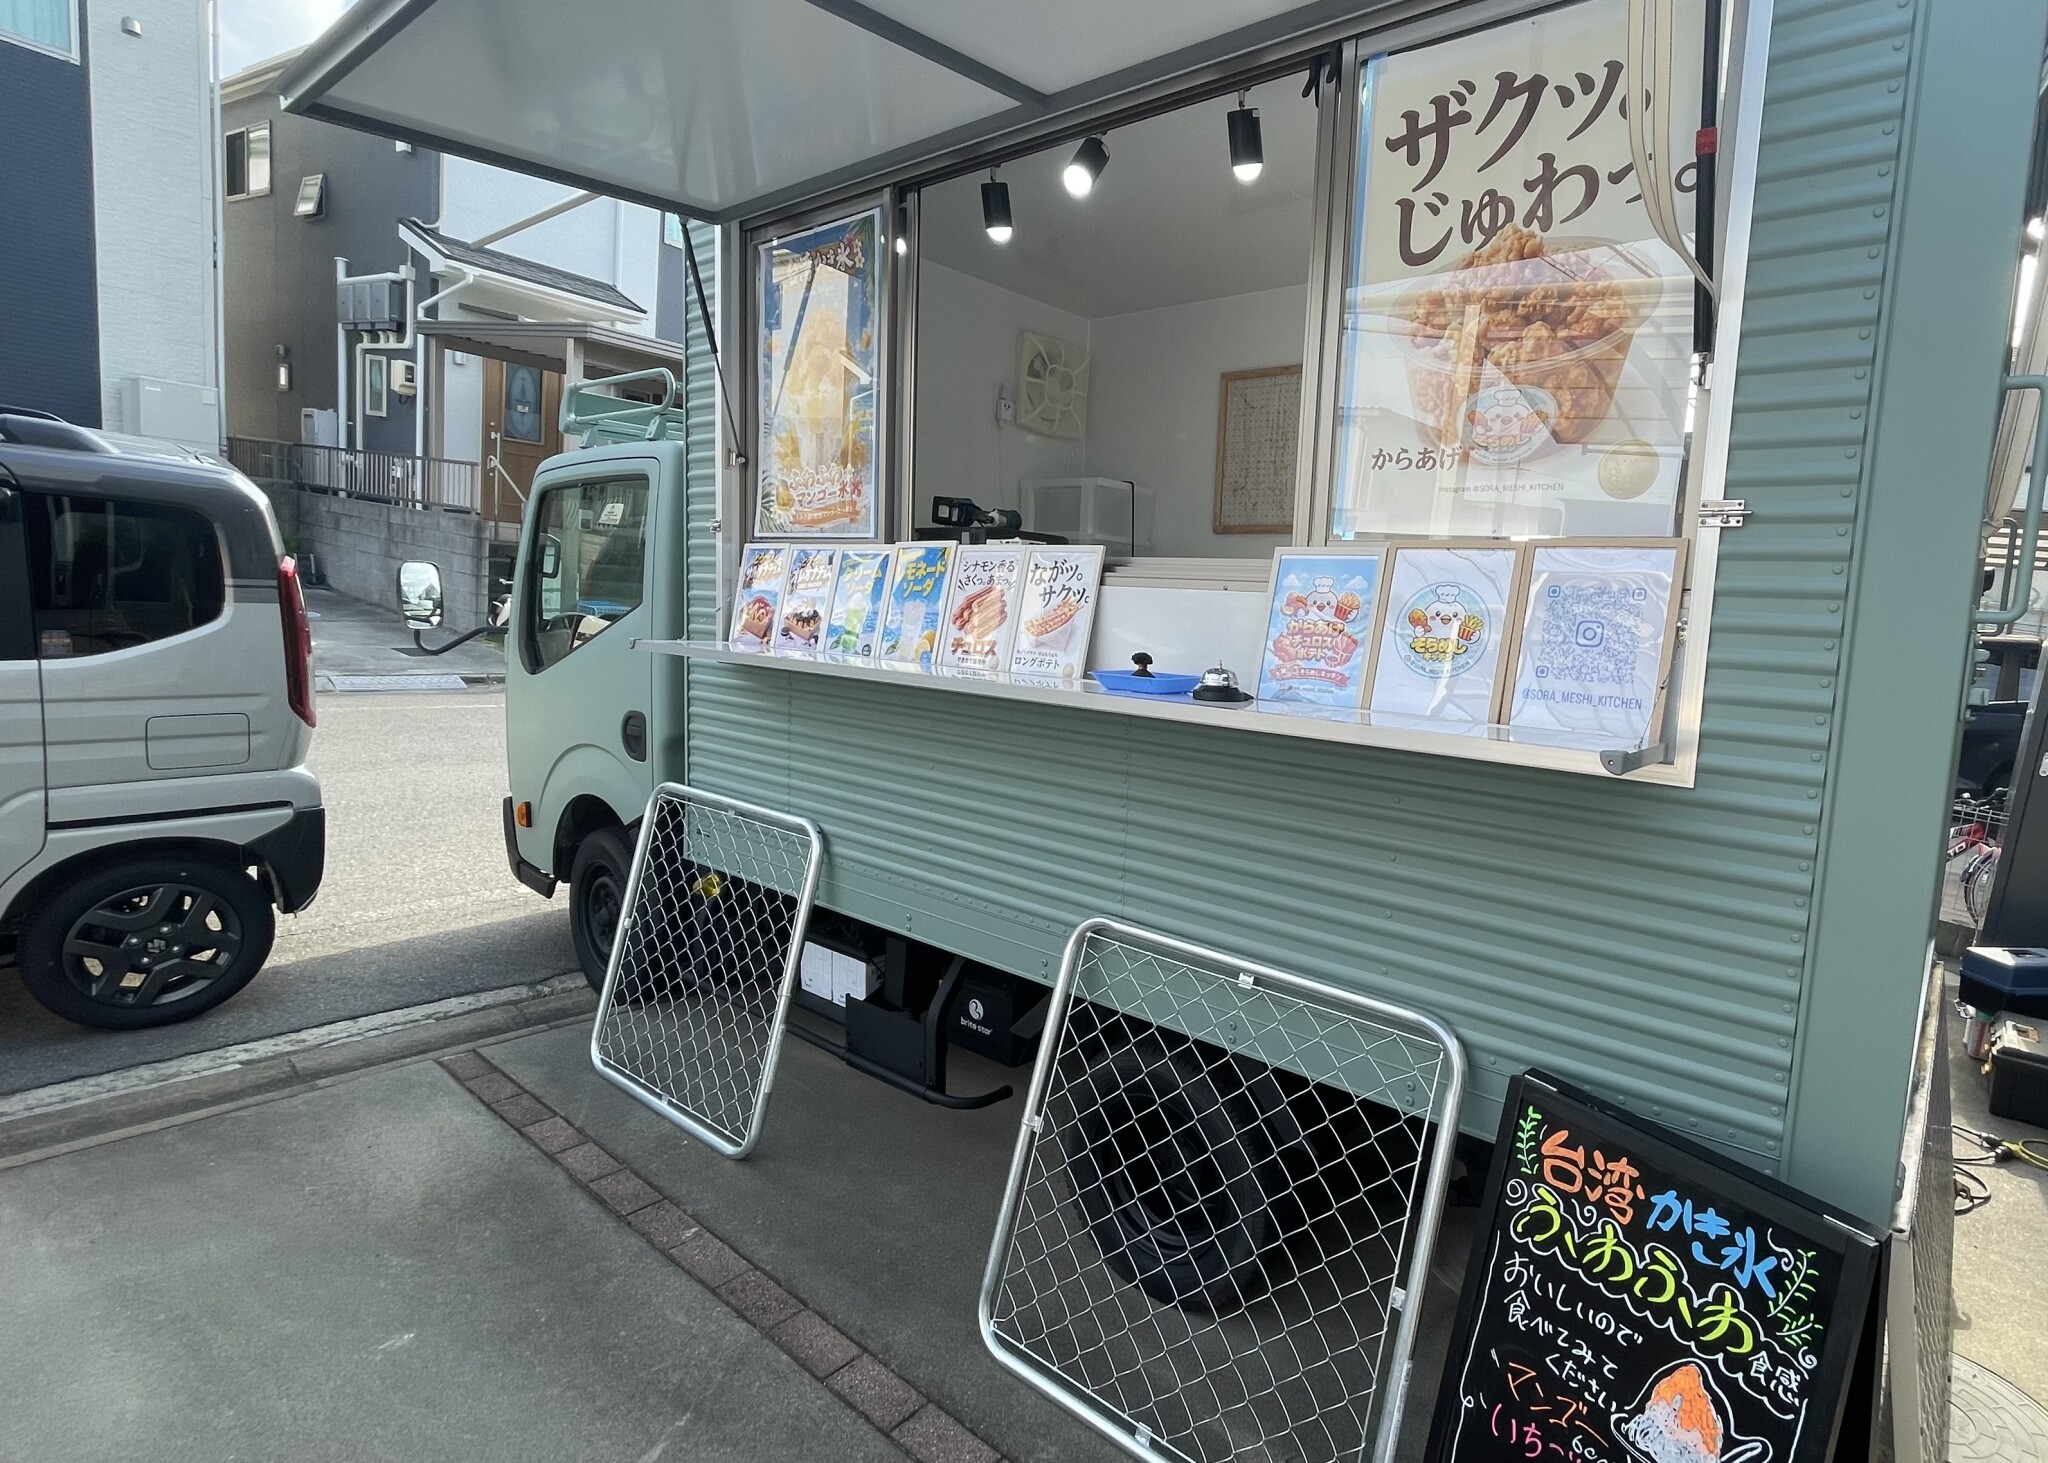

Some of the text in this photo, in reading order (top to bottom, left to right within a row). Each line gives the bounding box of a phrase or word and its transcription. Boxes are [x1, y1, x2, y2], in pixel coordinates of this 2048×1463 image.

[1370, 445, 1463, 472] からあげ
[796, 480, 850, 509] マンゴー氷
[1473, 482, 1565, 494] @SORA_MESHI_KITCHEN
[962, 559, 1016, 573] シナモン香る
[903, 578, 935, 598] ソーダ
[951, 636, 998, 658] チュロス
[1410, 637, 1469, 655] そらめし
[1014, 656, 1060, 671] ロングポテト
[1522, 687, 1643, 711] @SORA_MESHI_KITCHEN
[1540, 1129, 1778, 1299] 台湾 かき氷
[1503, 1251, 1644, 1347] おいしいので
[1503, 1289, 1619, 1380] 食べてみて
[1545, 1353, 1617, 1413] ください
[1747, 1350, 1800, 1407] 食感
[1507, 1361, 1610, 1448] マンゴー
